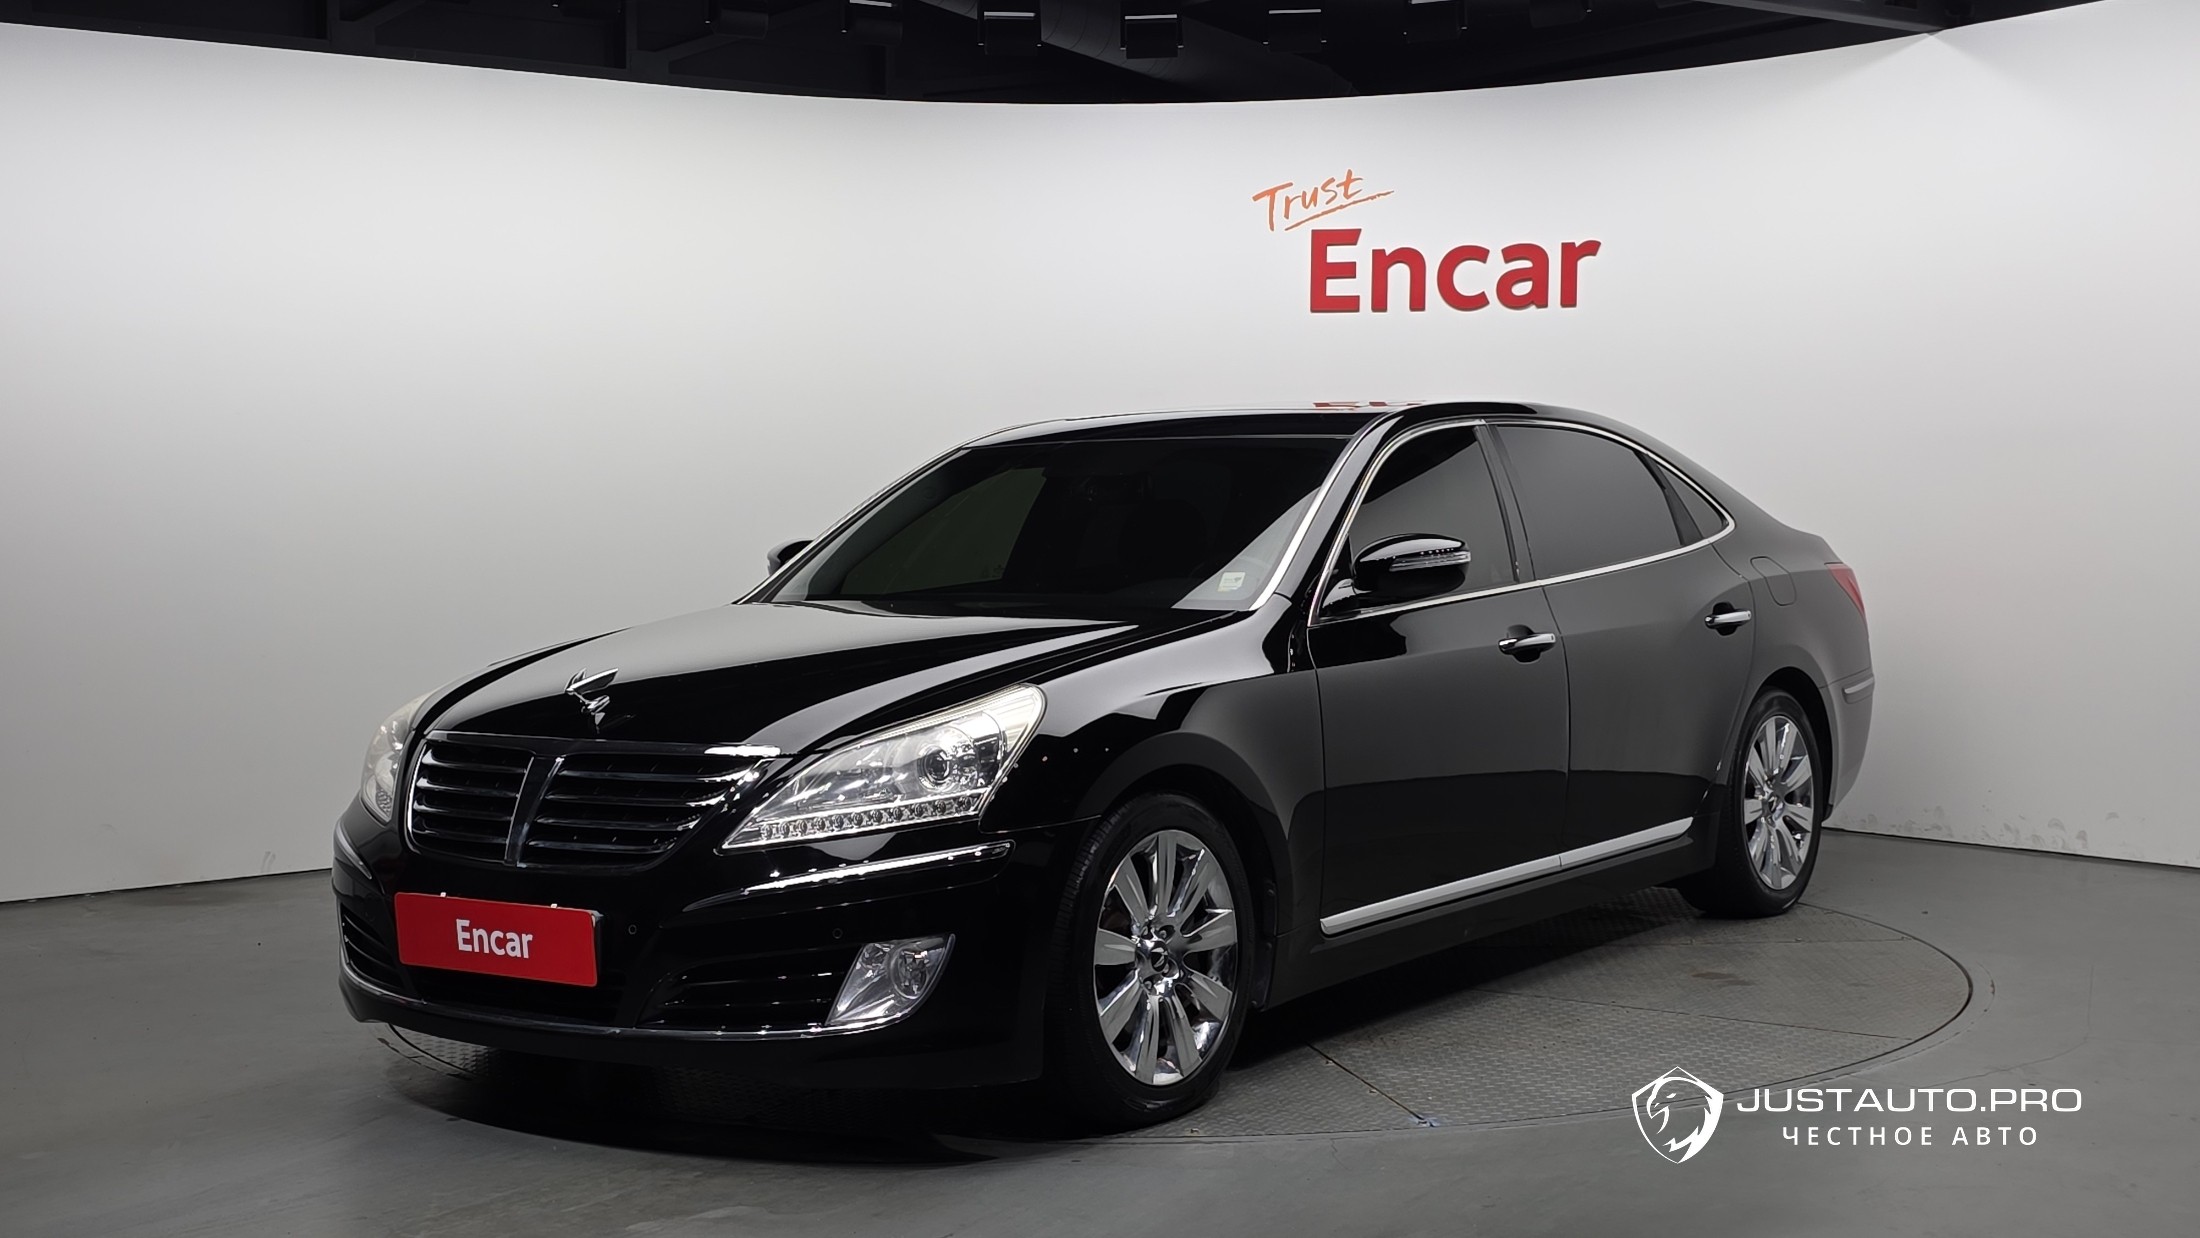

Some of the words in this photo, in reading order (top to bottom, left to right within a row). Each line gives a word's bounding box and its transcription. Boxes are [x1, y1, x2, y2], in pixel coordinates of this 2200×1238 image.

[1252, 169, 1364, 231] Trust
[1310, 229, 1601, 312] Encar
[455, 918, 533, 959] Encar
